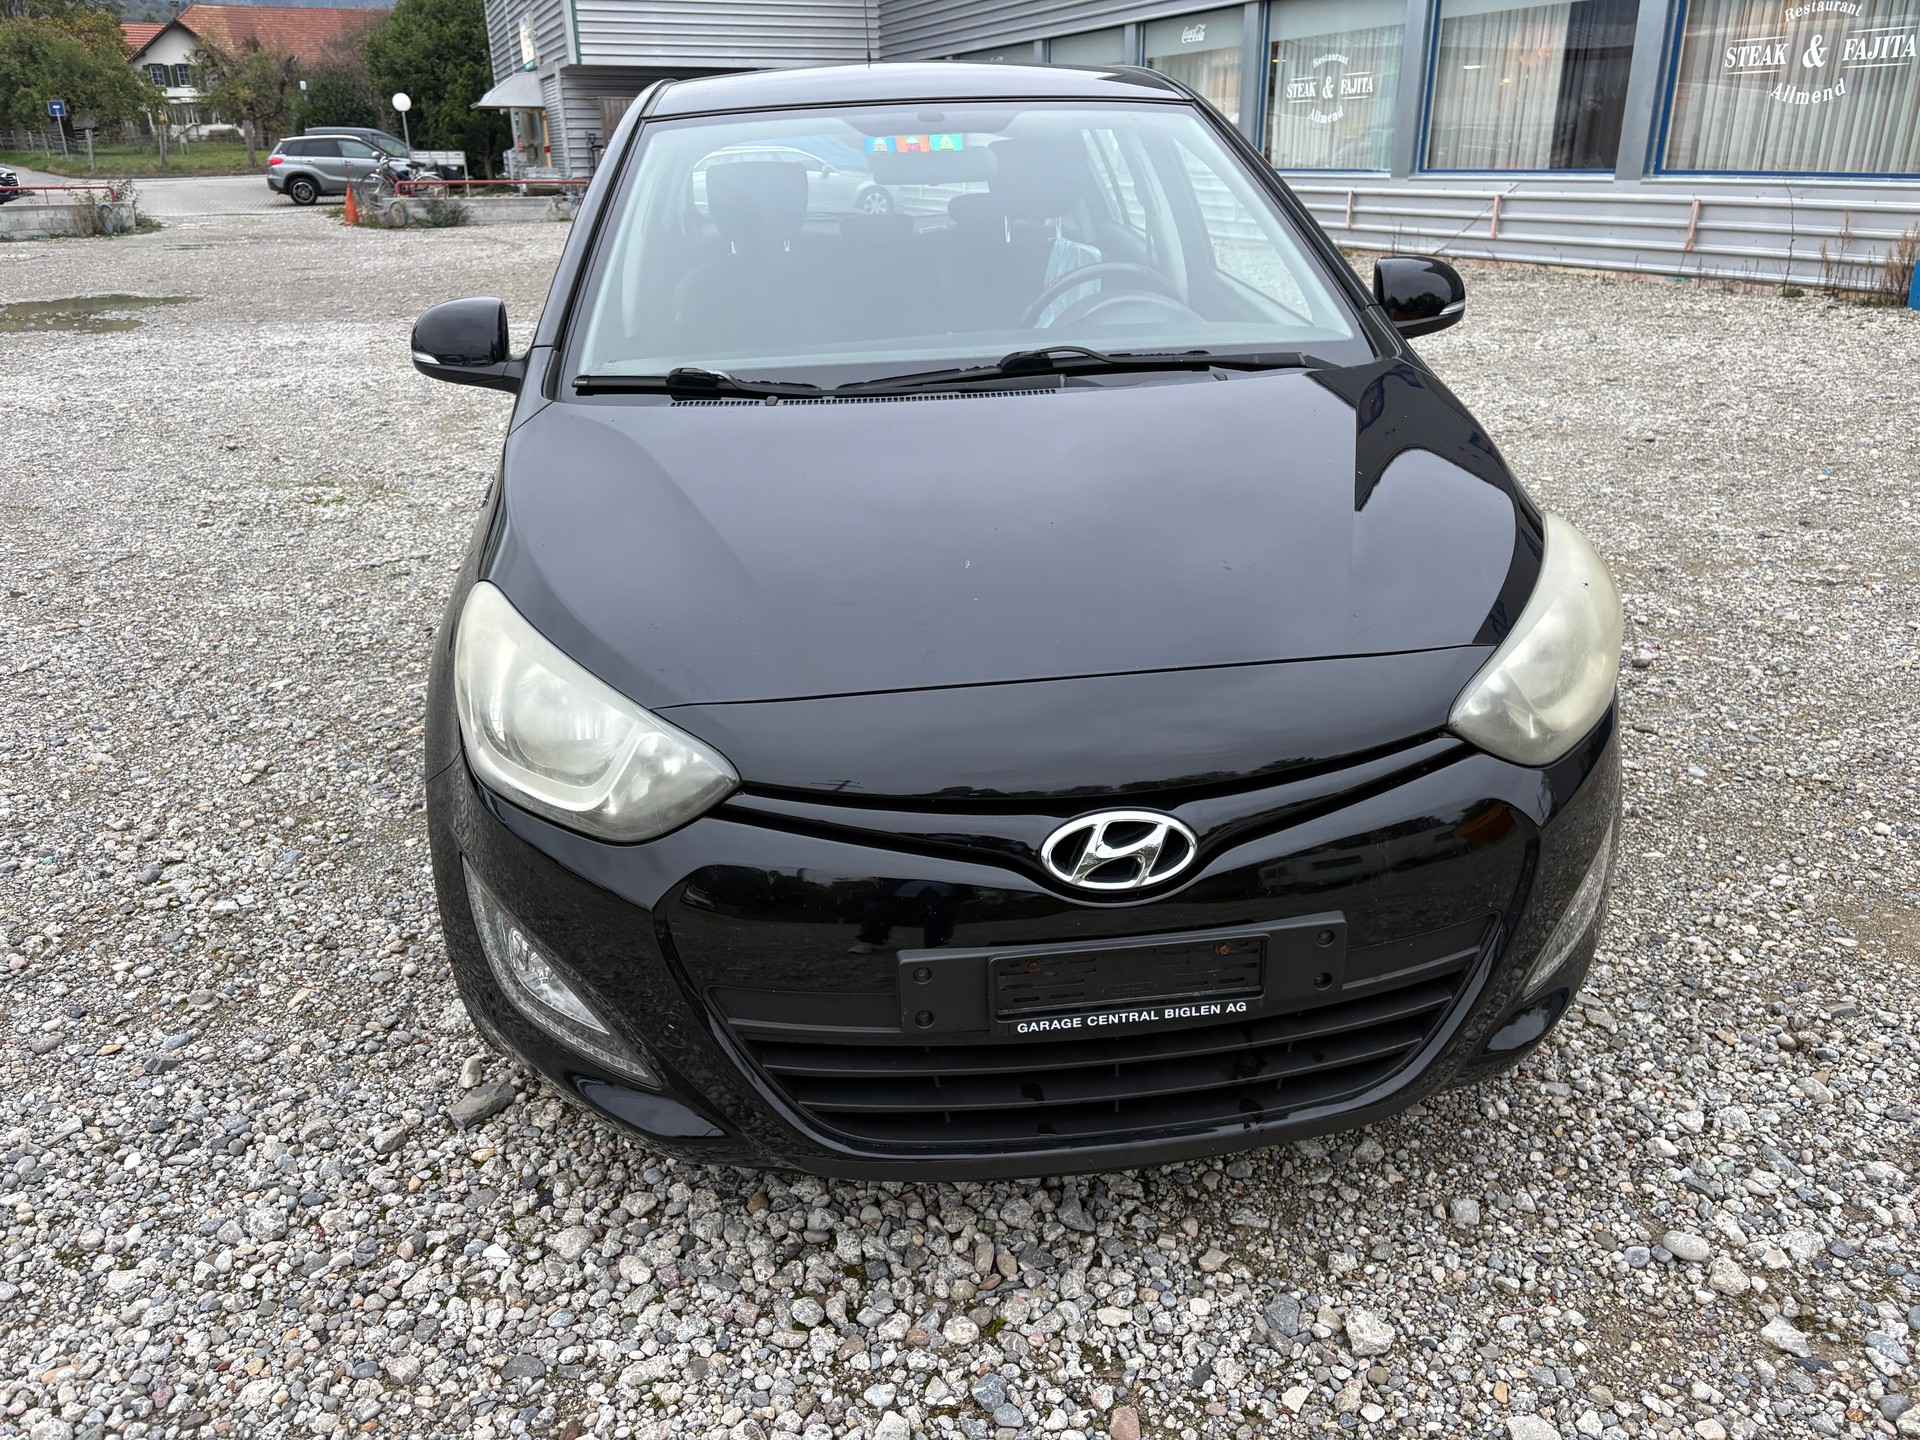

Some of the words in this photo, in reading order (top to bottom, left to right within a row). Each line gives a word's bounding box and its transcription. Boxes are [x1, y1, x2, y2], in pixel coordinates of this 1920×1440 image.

[1784, 0, 1863, 23] Restaurant
[1312, 53, 1349, 68] Restaurant
[1724, 42, 1789, 68] STEAK
[1802, 34, 1828, 69] &
[1841, 33, 1917, 62] FAJITA
[1286, 81, 1316, 98] STEAK
[1322, 75, 1335, 99] &
[1340, 77, 1374, 95] FAJITA
[1770, 77, 1846, 105] Allmend
[1307, 105, 1344, 124] Allmend
[1016, 1017, 1082, 1034] GARAGE
[1087, 1009, 1159, 1027] CENTRAL
[1164, 1003, 1221, 1020] BIGLEN
[1225, 1001, 1247, 1013] AG
